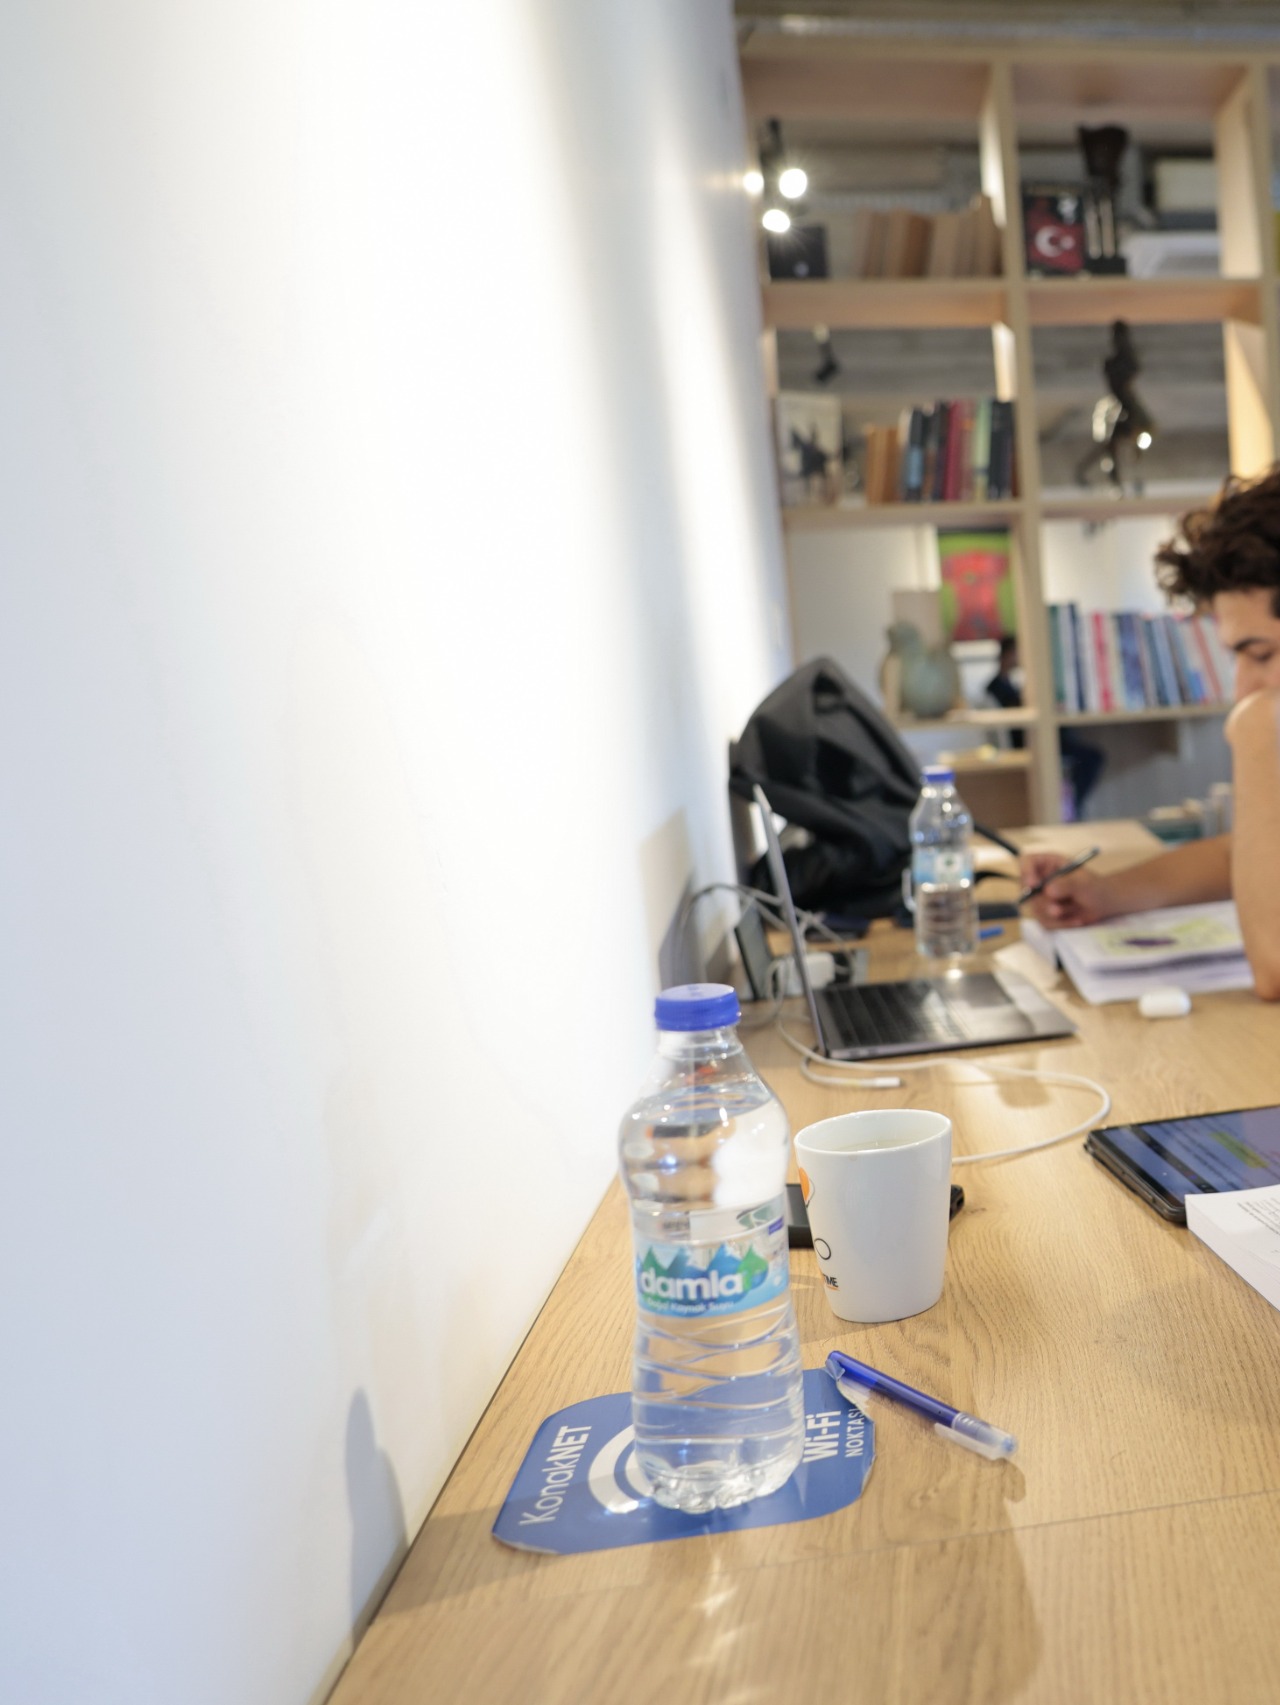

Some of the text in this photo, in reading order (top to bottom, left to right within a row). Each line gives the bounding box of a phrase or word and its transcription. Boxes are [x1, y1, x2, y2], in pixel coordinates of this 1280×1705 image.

[640, 1267, 743, 1300] damla
[802, 1410, 841, 1463] Wi-Fi
[518, 1426, 592, 1526] KonakNET
